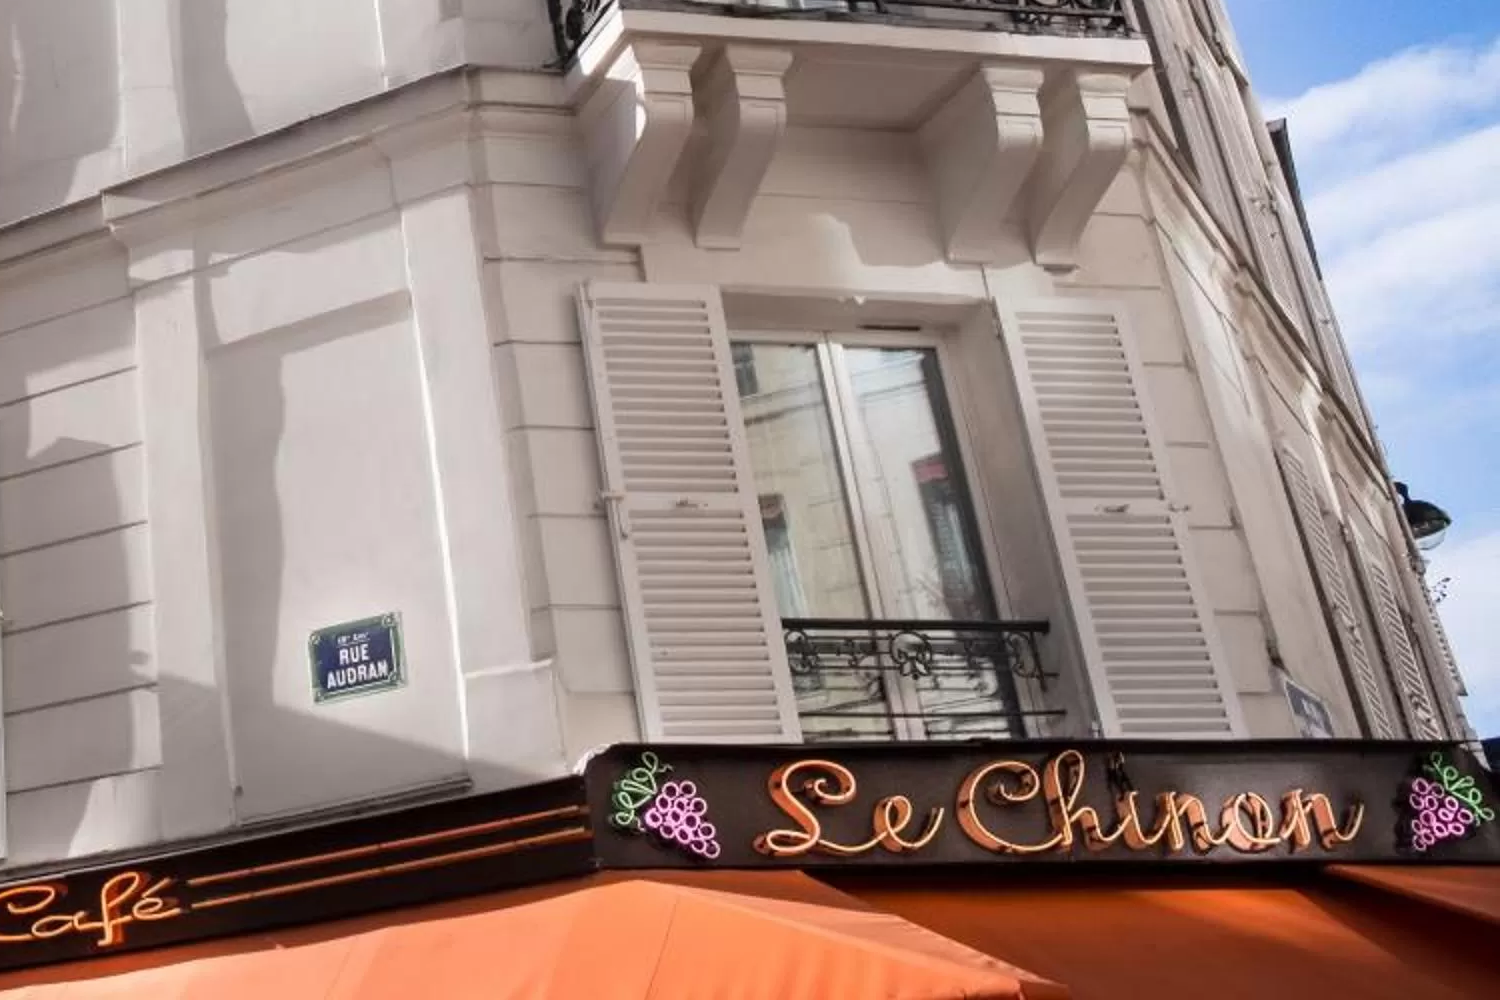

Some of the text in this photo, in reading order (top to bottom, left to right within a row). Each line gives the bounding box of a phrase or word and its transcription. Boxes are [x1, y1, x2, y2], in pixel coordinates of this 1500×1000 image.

[339, 643, 370, 665] RUE
[327, 660, 389, 689] AUDRAN
[754, 749, 1365, 857] Le Chinon
